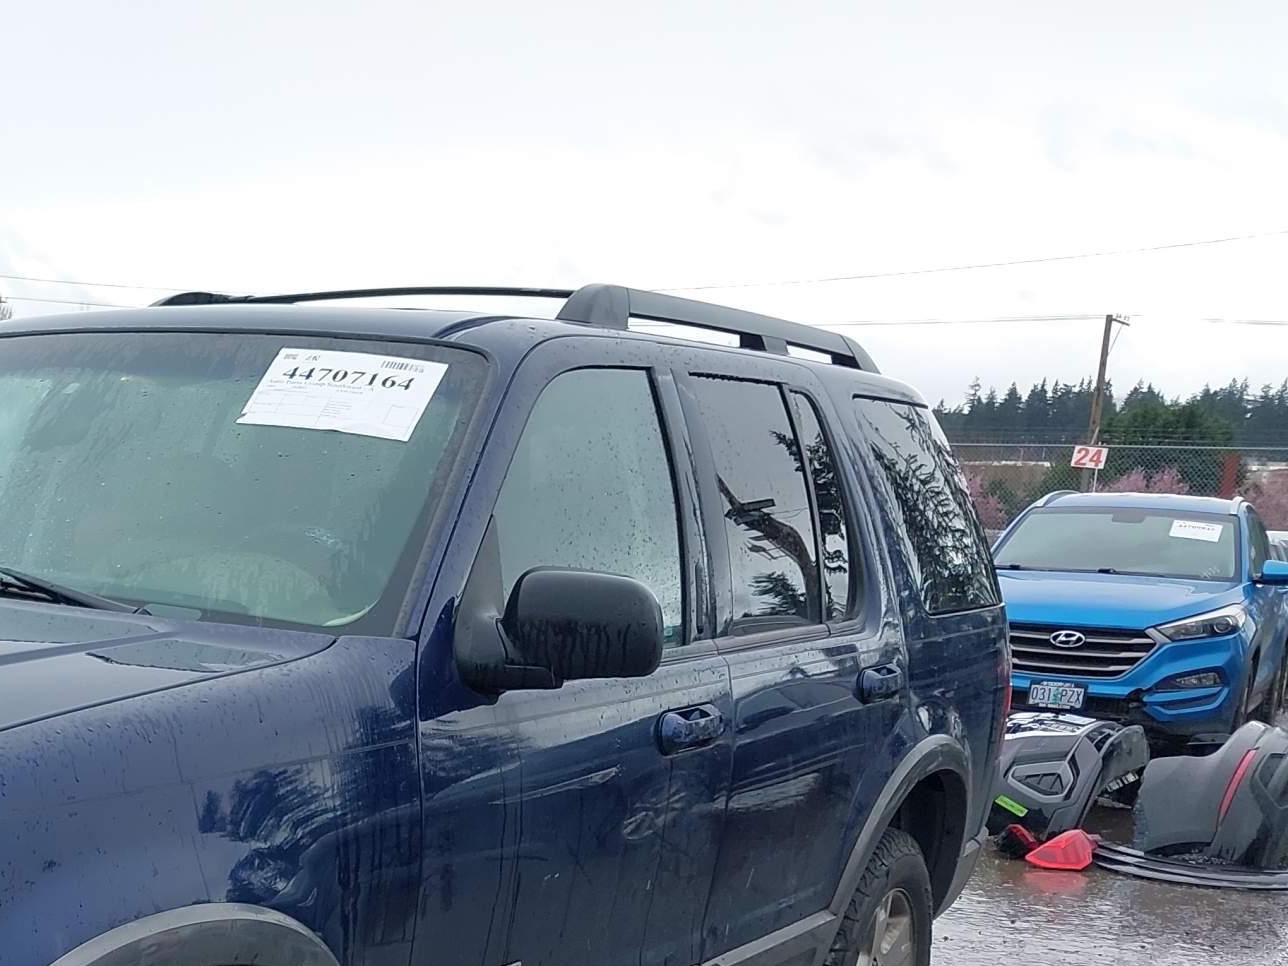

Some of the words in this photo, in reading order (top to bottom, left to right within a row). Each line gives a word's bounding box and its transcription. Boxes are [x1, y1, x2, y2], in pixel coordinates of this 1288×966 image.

[282, 366, 415, 391] 44707164
[1074, 447, 1103, 467] 24
[1032, 686, 1052, 701] 031
[1059, 688, 1083, 704] PZX
